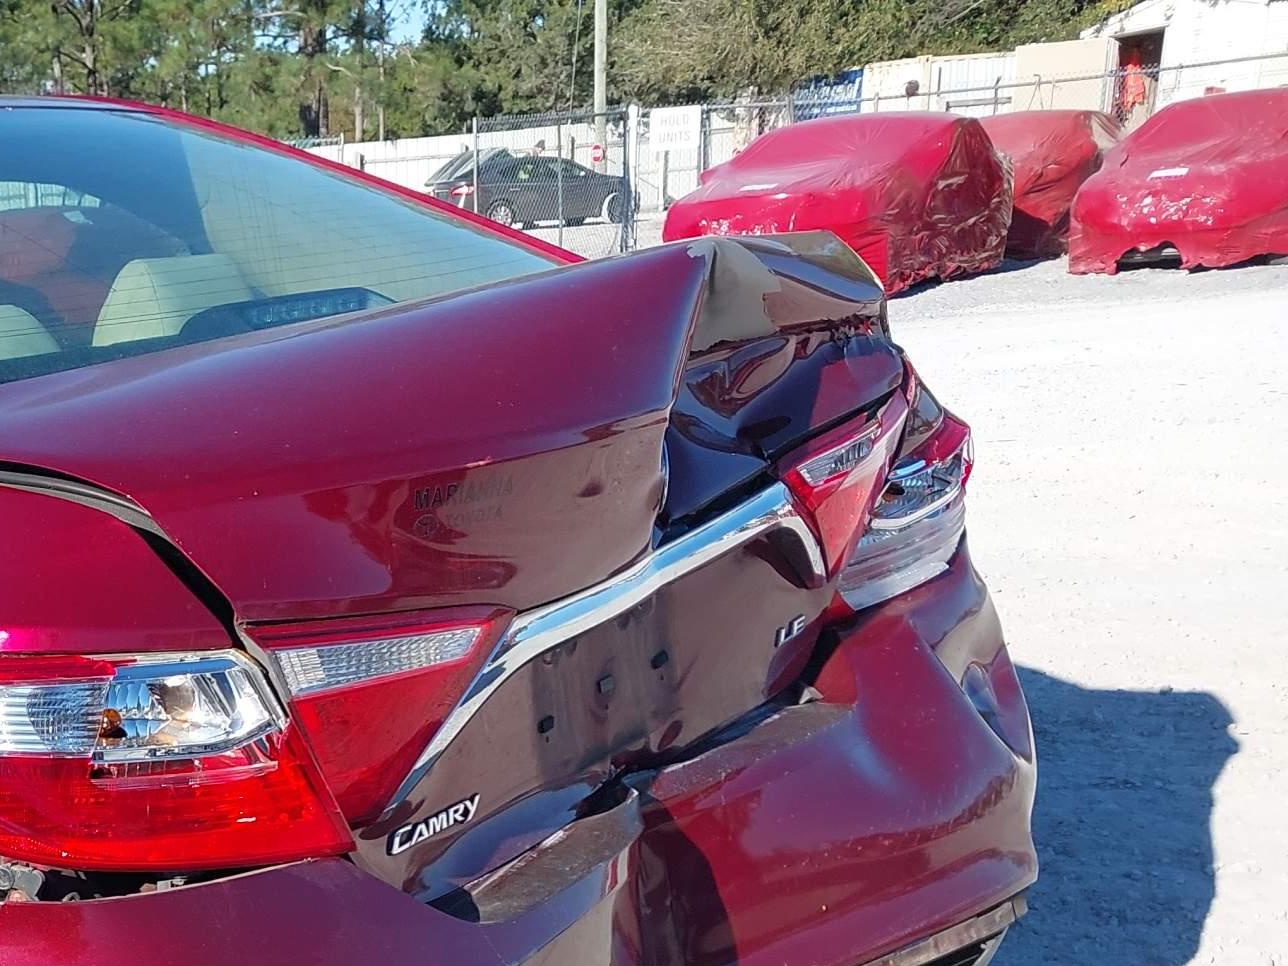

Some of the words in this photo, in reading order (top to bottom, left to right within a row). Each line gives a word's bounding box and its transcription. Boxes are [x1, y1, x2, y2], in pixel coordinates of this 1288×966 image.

[660, 112, 690, 127] HOLD
[658, 130, 691, 144] UNITS
[774, 613, 806, 648] LE
[387, 793, 480, 856] CAMRY
